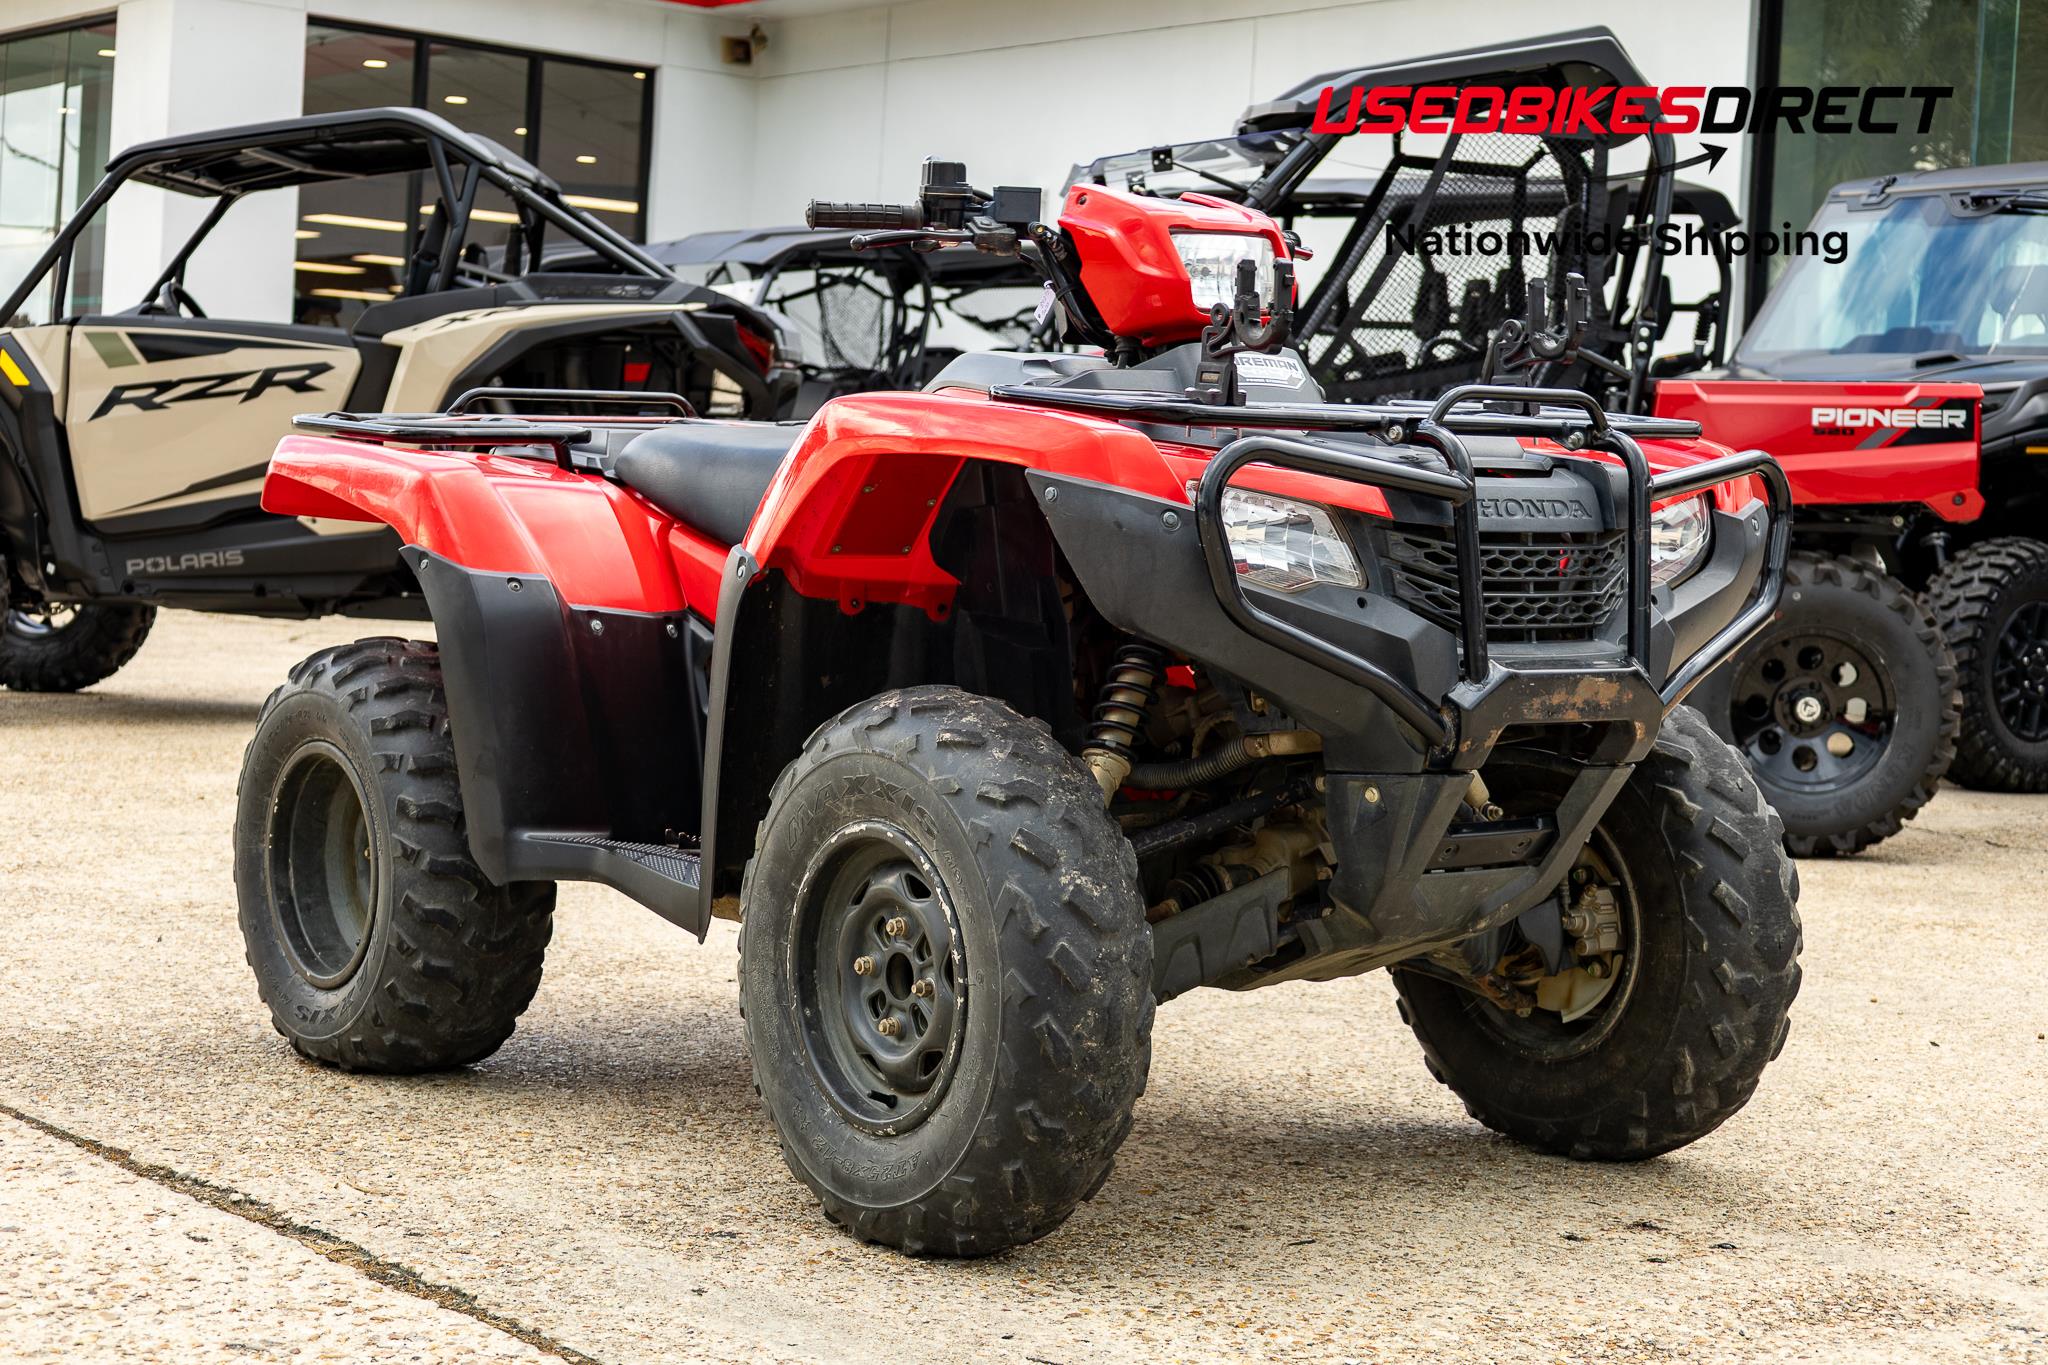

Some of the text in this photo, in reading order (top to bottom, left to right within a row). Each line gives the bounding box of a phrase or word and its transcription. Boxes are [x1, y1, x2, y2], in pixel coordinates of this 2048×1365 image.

[1234, 356, 1299, 372] REMAN
[87, 361, 336, 422] RZR
[1811, 407, 1967, 429] PIONEER
[1477, 498, 1593, 519] HONDA
[126, 549, 245, 576] POLARIS
[788, 773, 940, 849] MAXXIS
